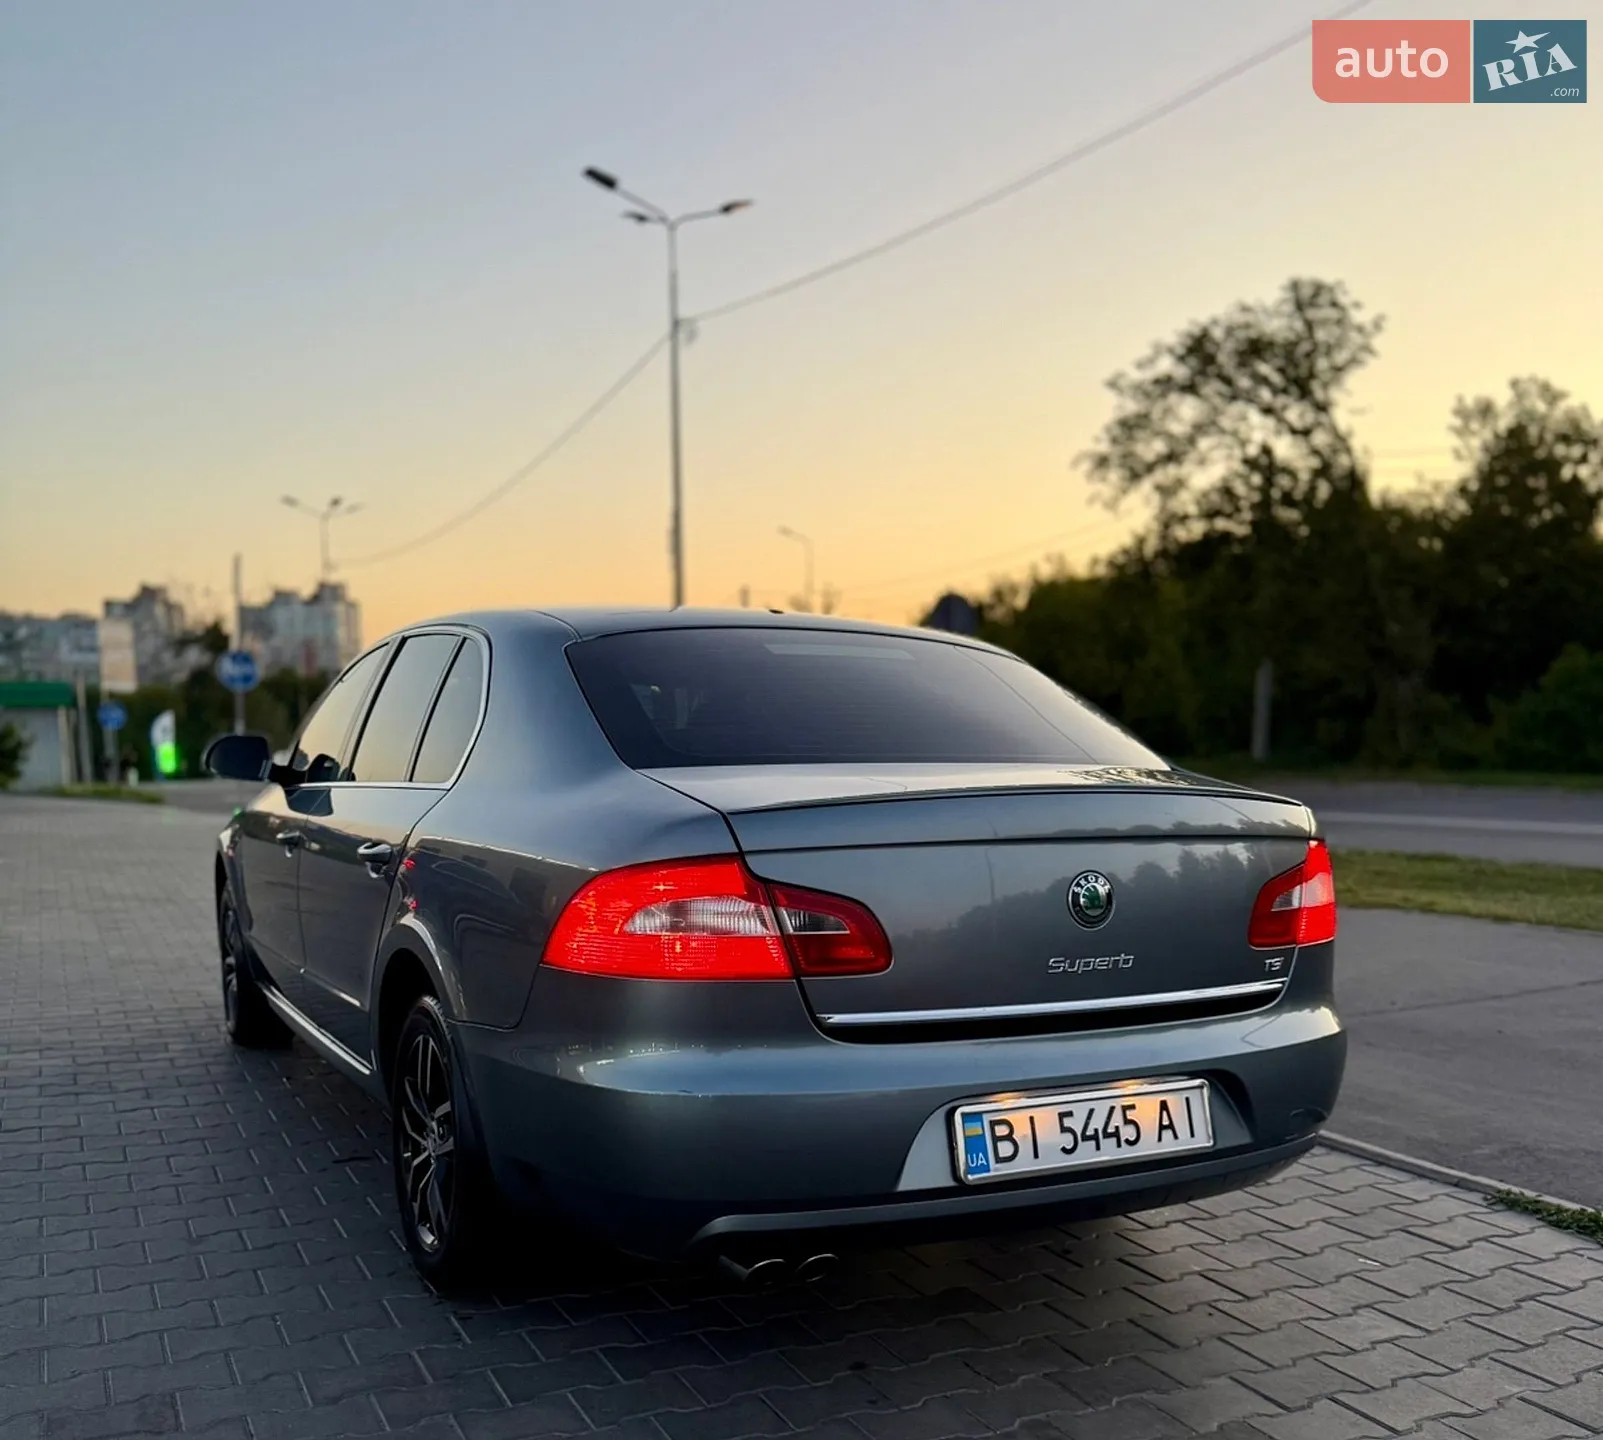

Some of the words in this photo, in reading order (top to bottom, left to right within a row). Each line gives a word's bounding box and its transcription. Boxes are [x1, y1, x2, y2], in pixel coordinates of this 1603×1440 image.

[1047, 953, 1135, 975] Superb
[988, 1115, 1040, 1164] BI
[1057, 1103, 1142, 1156] 5445
[1156, 1096, 1196, 1143] AI
[967, 1152, 988, 1168] UA
